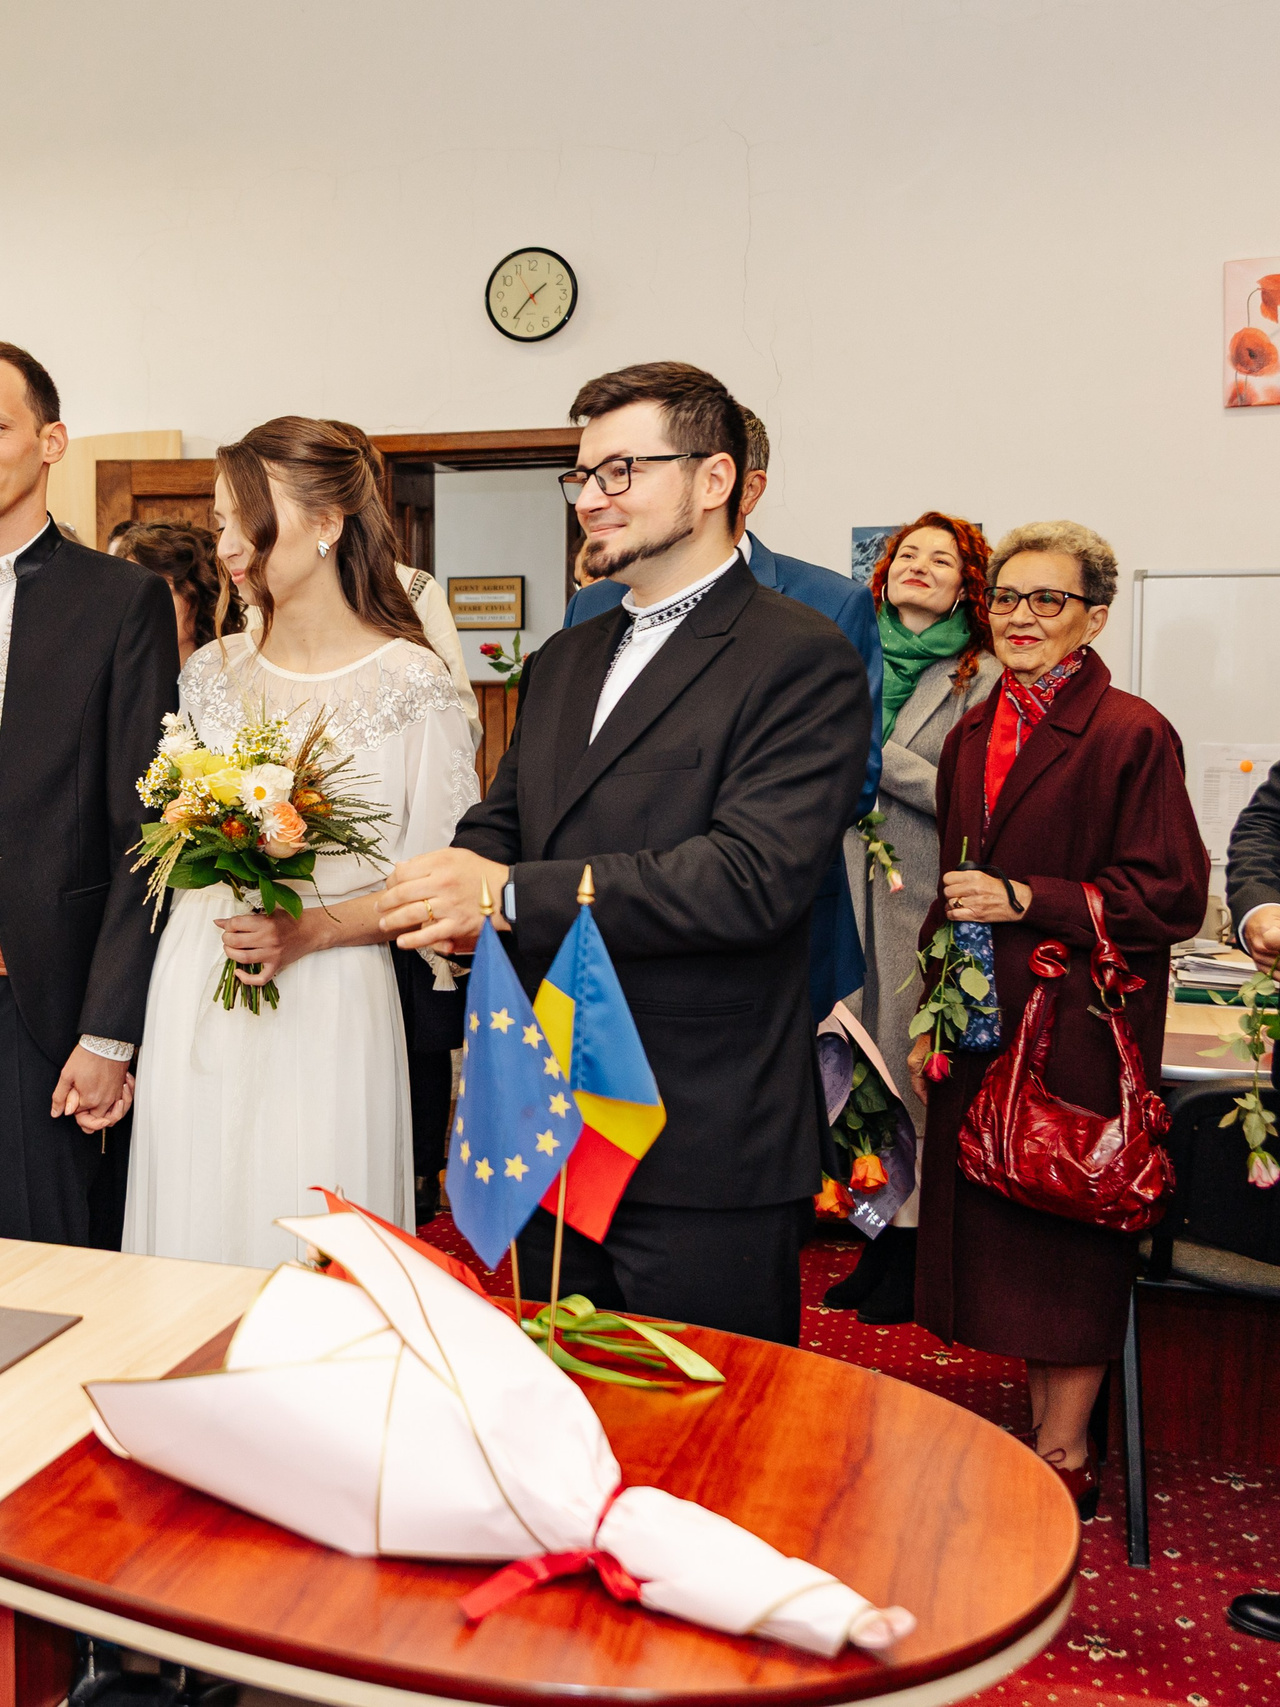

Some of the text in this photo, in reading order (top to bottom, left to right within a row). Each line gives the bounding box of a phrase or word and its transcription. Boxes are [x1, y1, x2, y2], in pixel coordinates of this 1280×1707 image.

[515, 264, 522, 276] 11
[527, 259, 538, 271] 12
[502, 275, 513, 287] 10
[556, 274, 564, 285] 2
[496, 291, 505, 302] 9
[559, 288, 568, 300] 3
[500, 306, 509, 318] 8
[554, 305, 562, 316] 4
[526, 321, 535, 332] 6
[541, 316, 550, 328] 5
